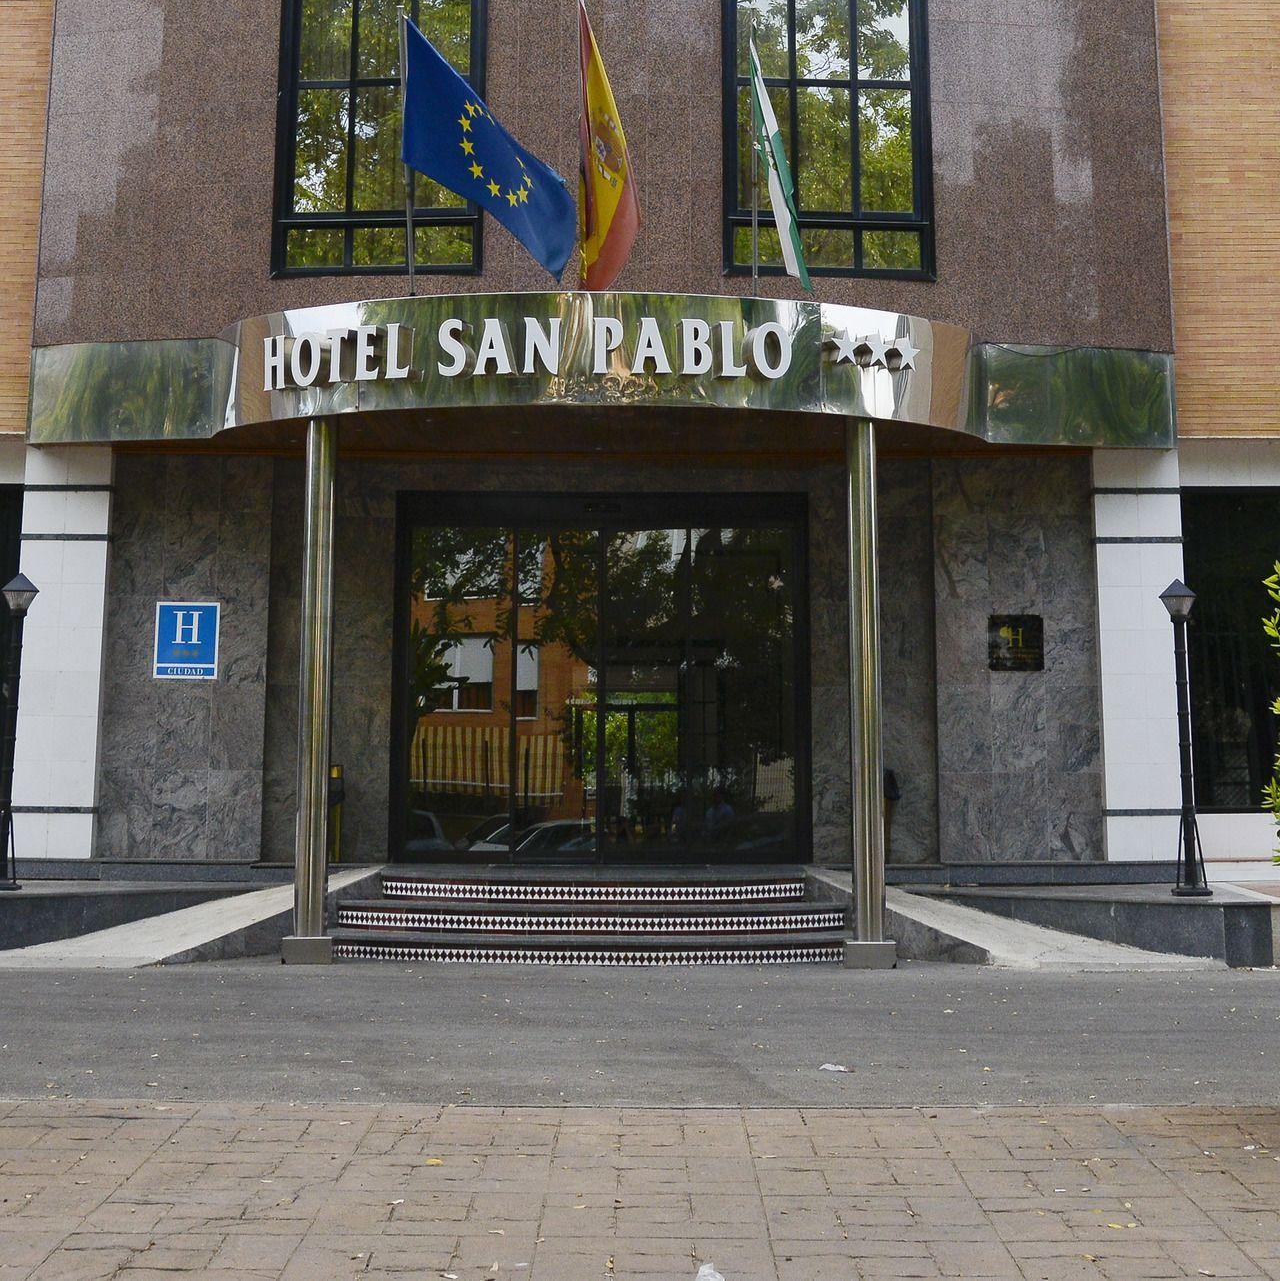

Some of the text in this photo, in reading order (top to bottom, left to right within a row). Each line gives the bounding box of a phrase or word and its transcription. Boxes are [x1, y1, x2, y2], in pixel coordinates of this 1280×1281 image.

[263, 317, 793, 391] HOTEL SAN PABLO
[171, 611, 203, 644] H
[167, 667, 203, 675] CIUDAD
